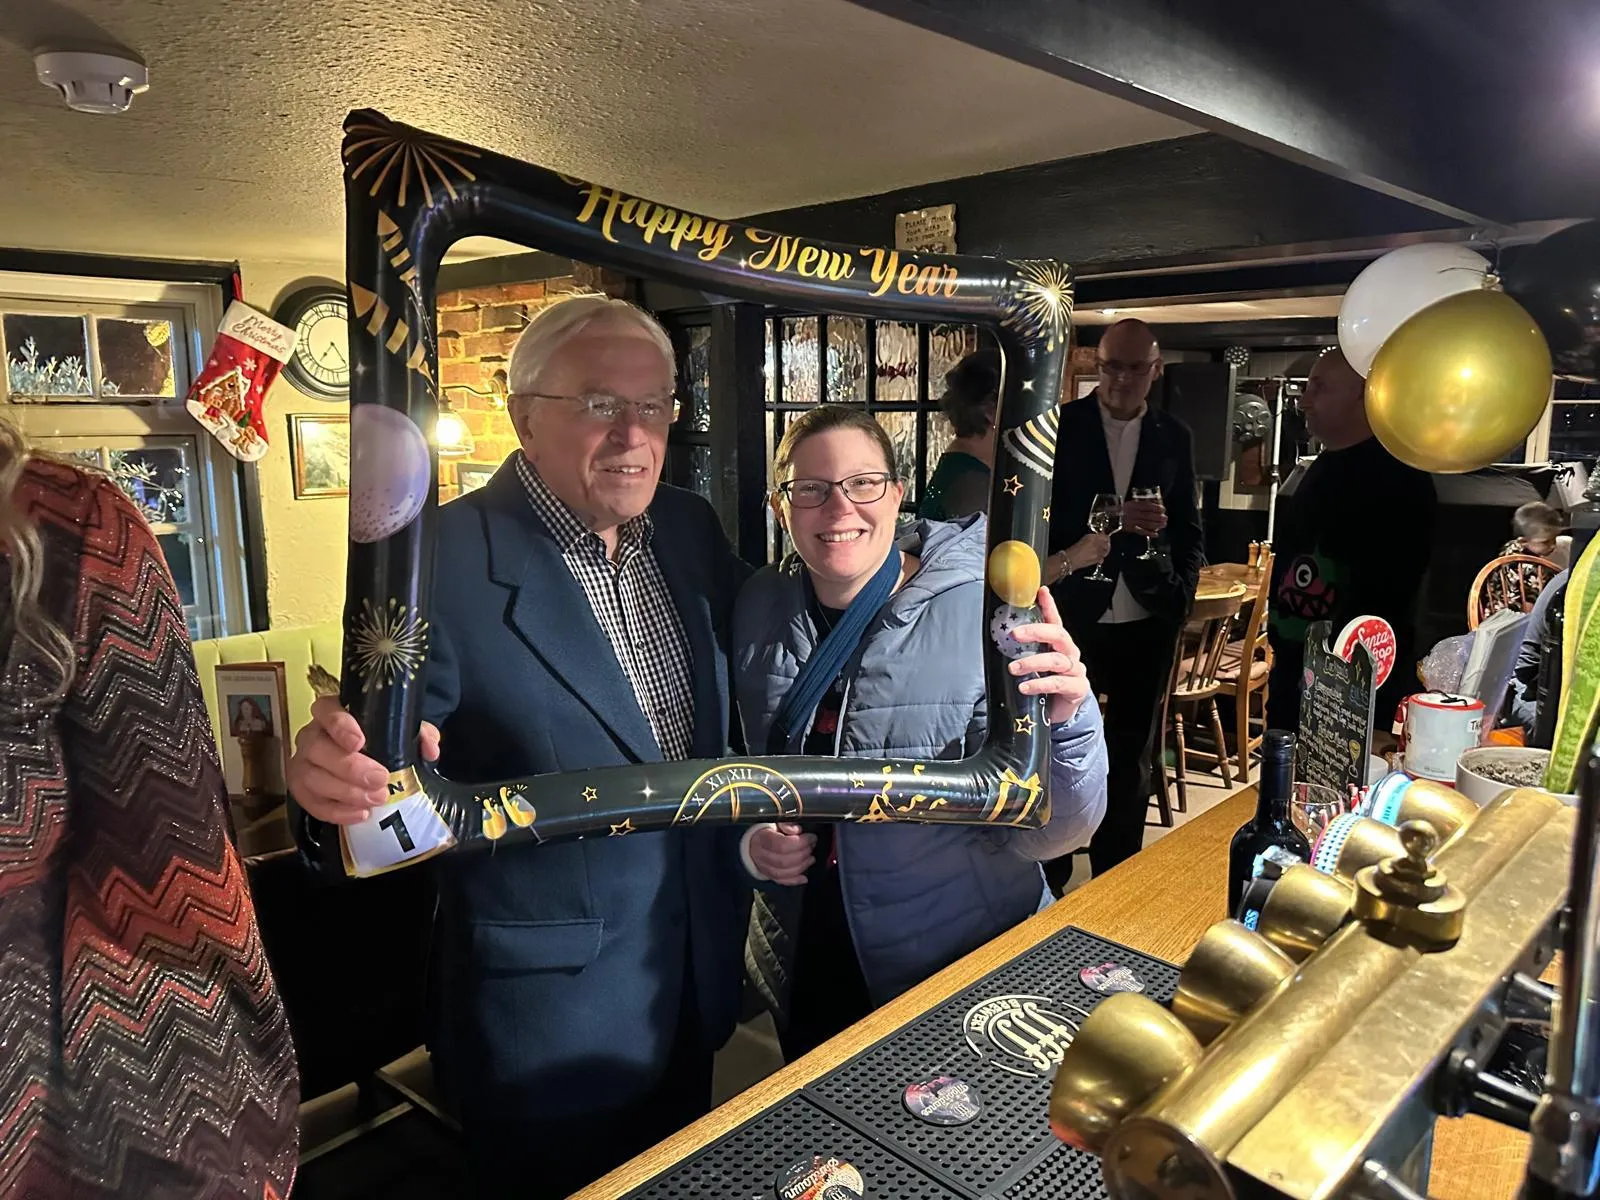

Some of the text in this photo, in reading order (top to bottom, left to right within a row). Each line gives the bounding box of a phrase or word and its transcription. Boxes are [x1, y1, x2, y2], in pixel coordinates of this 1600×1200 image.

[575, 183, 960, 297] Happy New Year
[232, 322, 286, 354] Christmas
[242, 315, 282, 342] Merry
[728, 768, 753, 780] XII
[378, 809, 416, 853] 1
[970, 998, 1021, 1036] BREWERY
